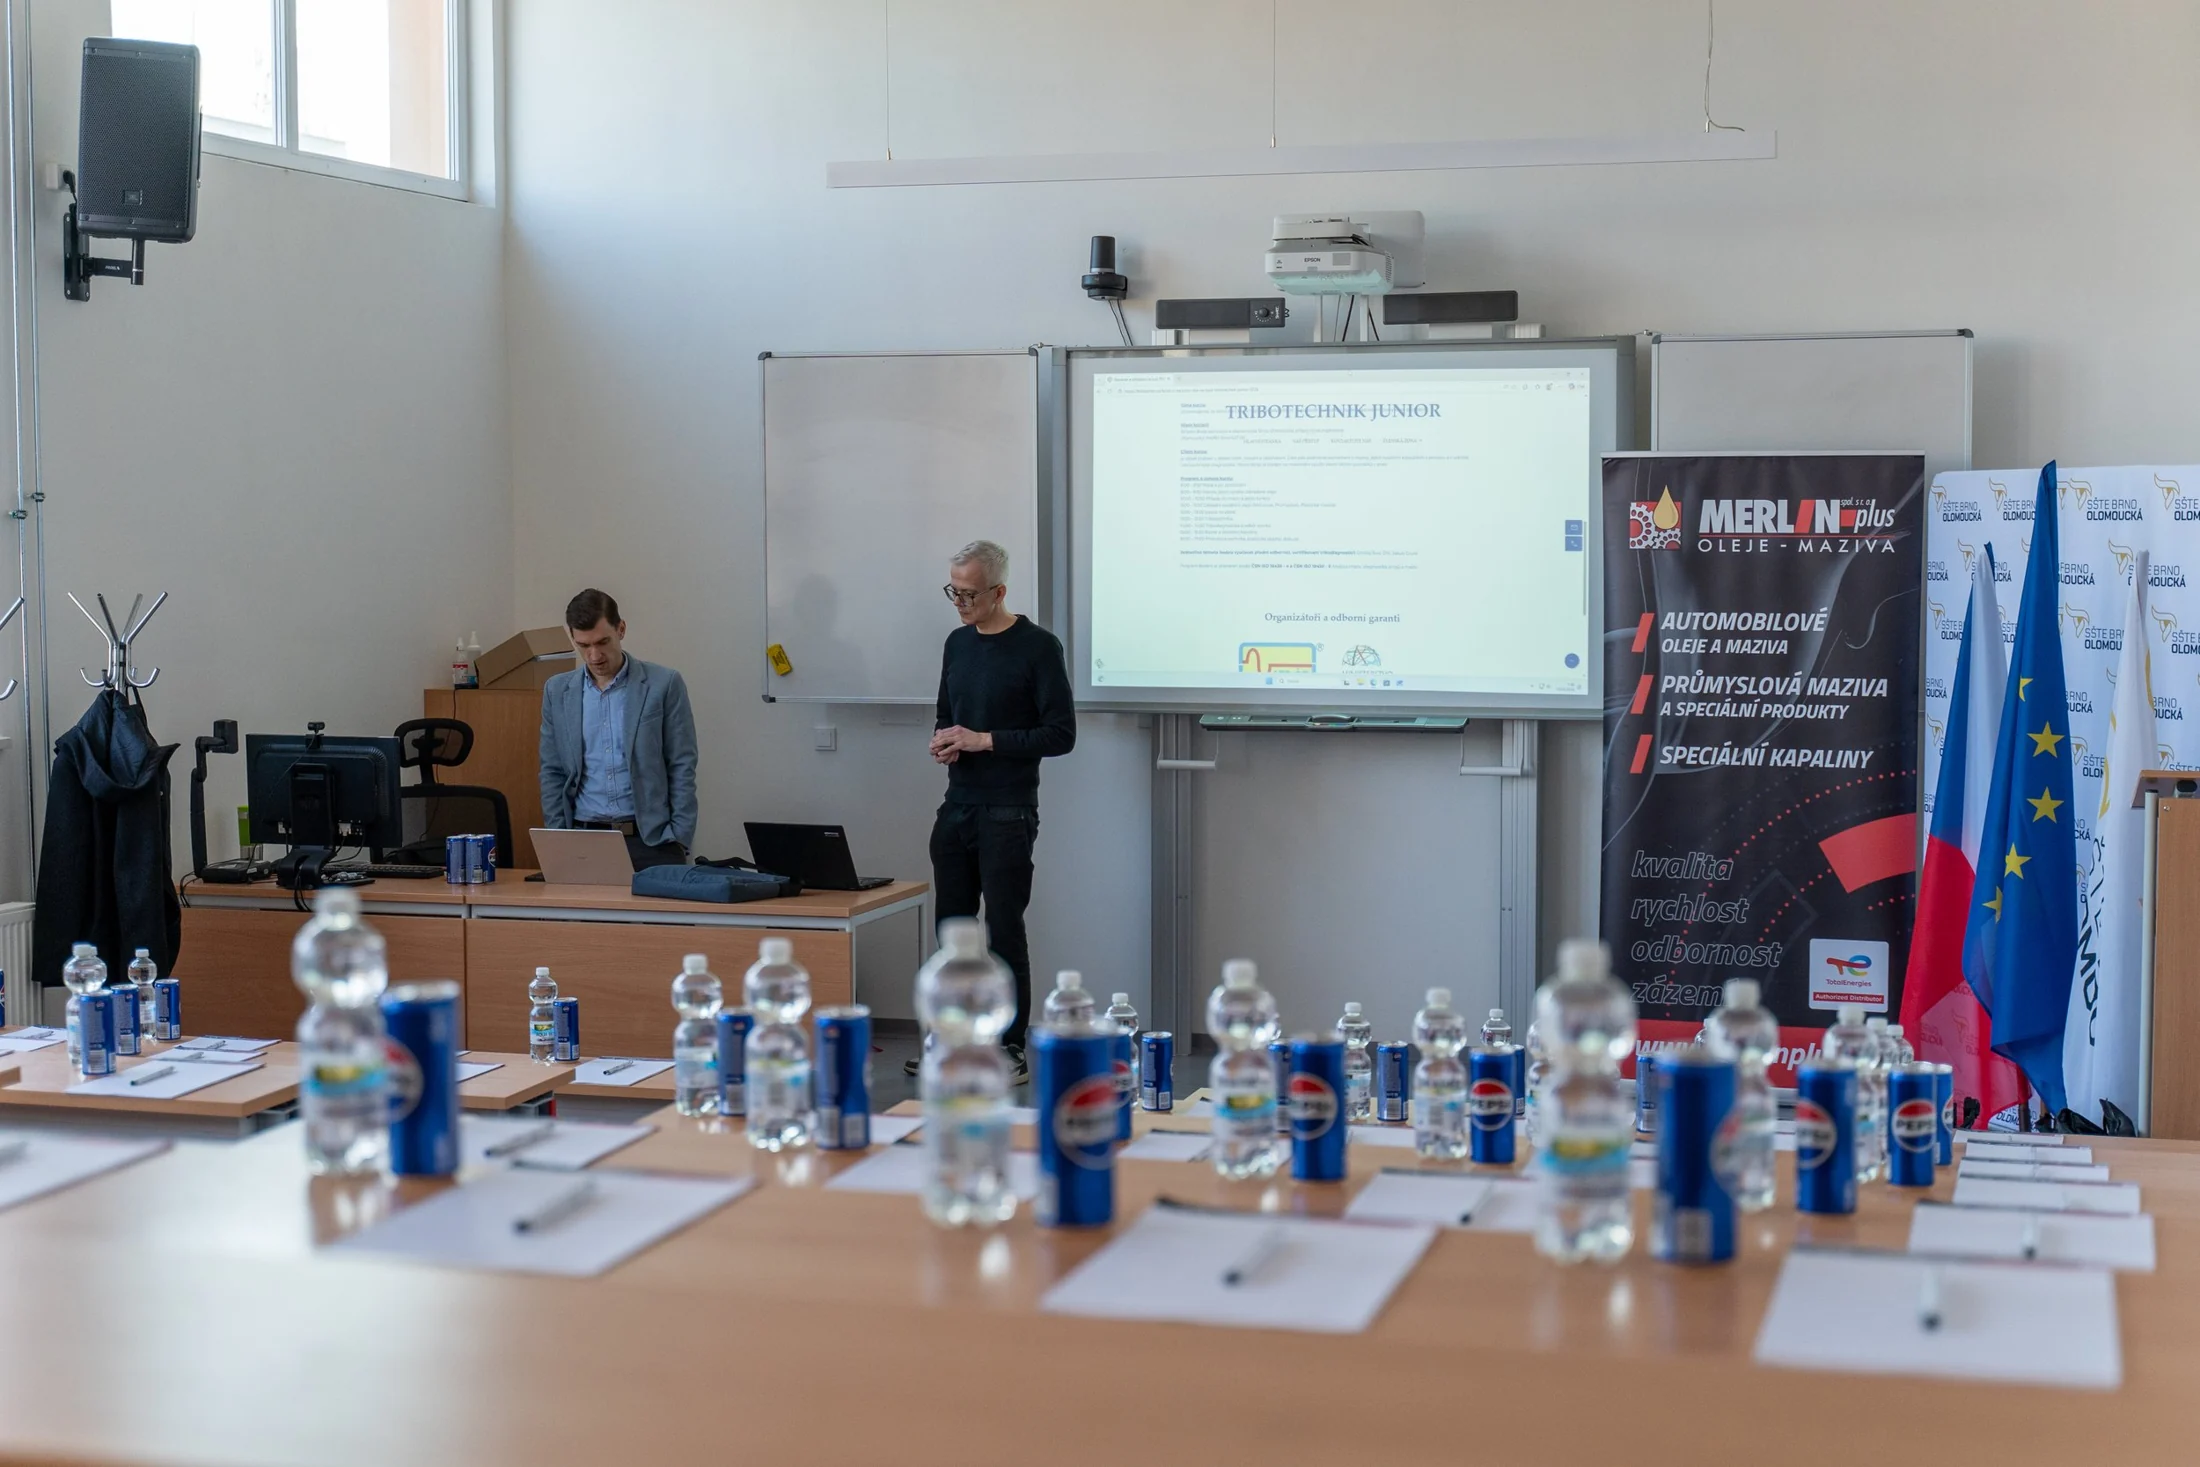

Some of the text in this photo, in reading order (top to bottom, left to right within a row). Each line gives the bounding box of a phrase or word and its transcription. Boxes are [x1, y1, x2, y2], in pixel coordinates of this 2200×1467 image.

[1225, 404, 1367, 419] TRIBOTECHNIK
[1370, 403, 1442, 422] JUNIOR
[1943, 501, 1978, 512] SŠTE BRNO
[2003, 499, 2036, 510] SŠTE BRN
[2087, 498, 2138, 510] SŠTE BRNO
[2174, 497, 2198, 510] SŠTE
[1699, 499, 1841, 534] MERLIN
[1854, 499, 1896, 534] plus
[1942, 510, 1982, 522] OLOMOUCKÁ
[2003, 511, 2036, 520] OLOMOUC
[2086, 508, 2143, 521] OLOMOUCKÁ
[1698, 538, 1768, 552] OLEJE
[1798, 539, 1896, 552] MAZIVA
[1927, 570, 1948, 581] OUCKÁ
[2064, 564, 2089, 574] BRNO
[2154, 566, 2180, 576] BRNO
[2148, 575, 2186, 587] MOUCKÁ
[1264, 612, 1320, 624] Organizátoři
[1368, 614, 1400, 624] garanti
[1660, 607, 1828, 632] AUTOMOBILOVÉ
[2084, 627, 2108, 639] SŠTE
[2172, 630, 2196, 643] SŠTE
[1661, 638, 1788, 654] OLEJE A MAZIVA
[2084, 640, 2122, 650] OLOMOU
[1661, 670, 1888, 698] PRŮMYSLOVÁ MAZIVA
[1926, 688, 1947, 698] OUCKÁ
[1660, 698, 1850, 720] A SPECIÁLNÍ PRODUKTY
[1660, 741, 1874, 768] SPECIÁLNÍ KAPALINY
[1631, 850, 1734, 880] kvalita
[1630, 894, 1750, 927] rychlost
[1631, 935, 1782, 968] odbornost
[1826, 978, 1872, 988] TotalEnergies
[1632, 974, 1732, 1006] zázem
